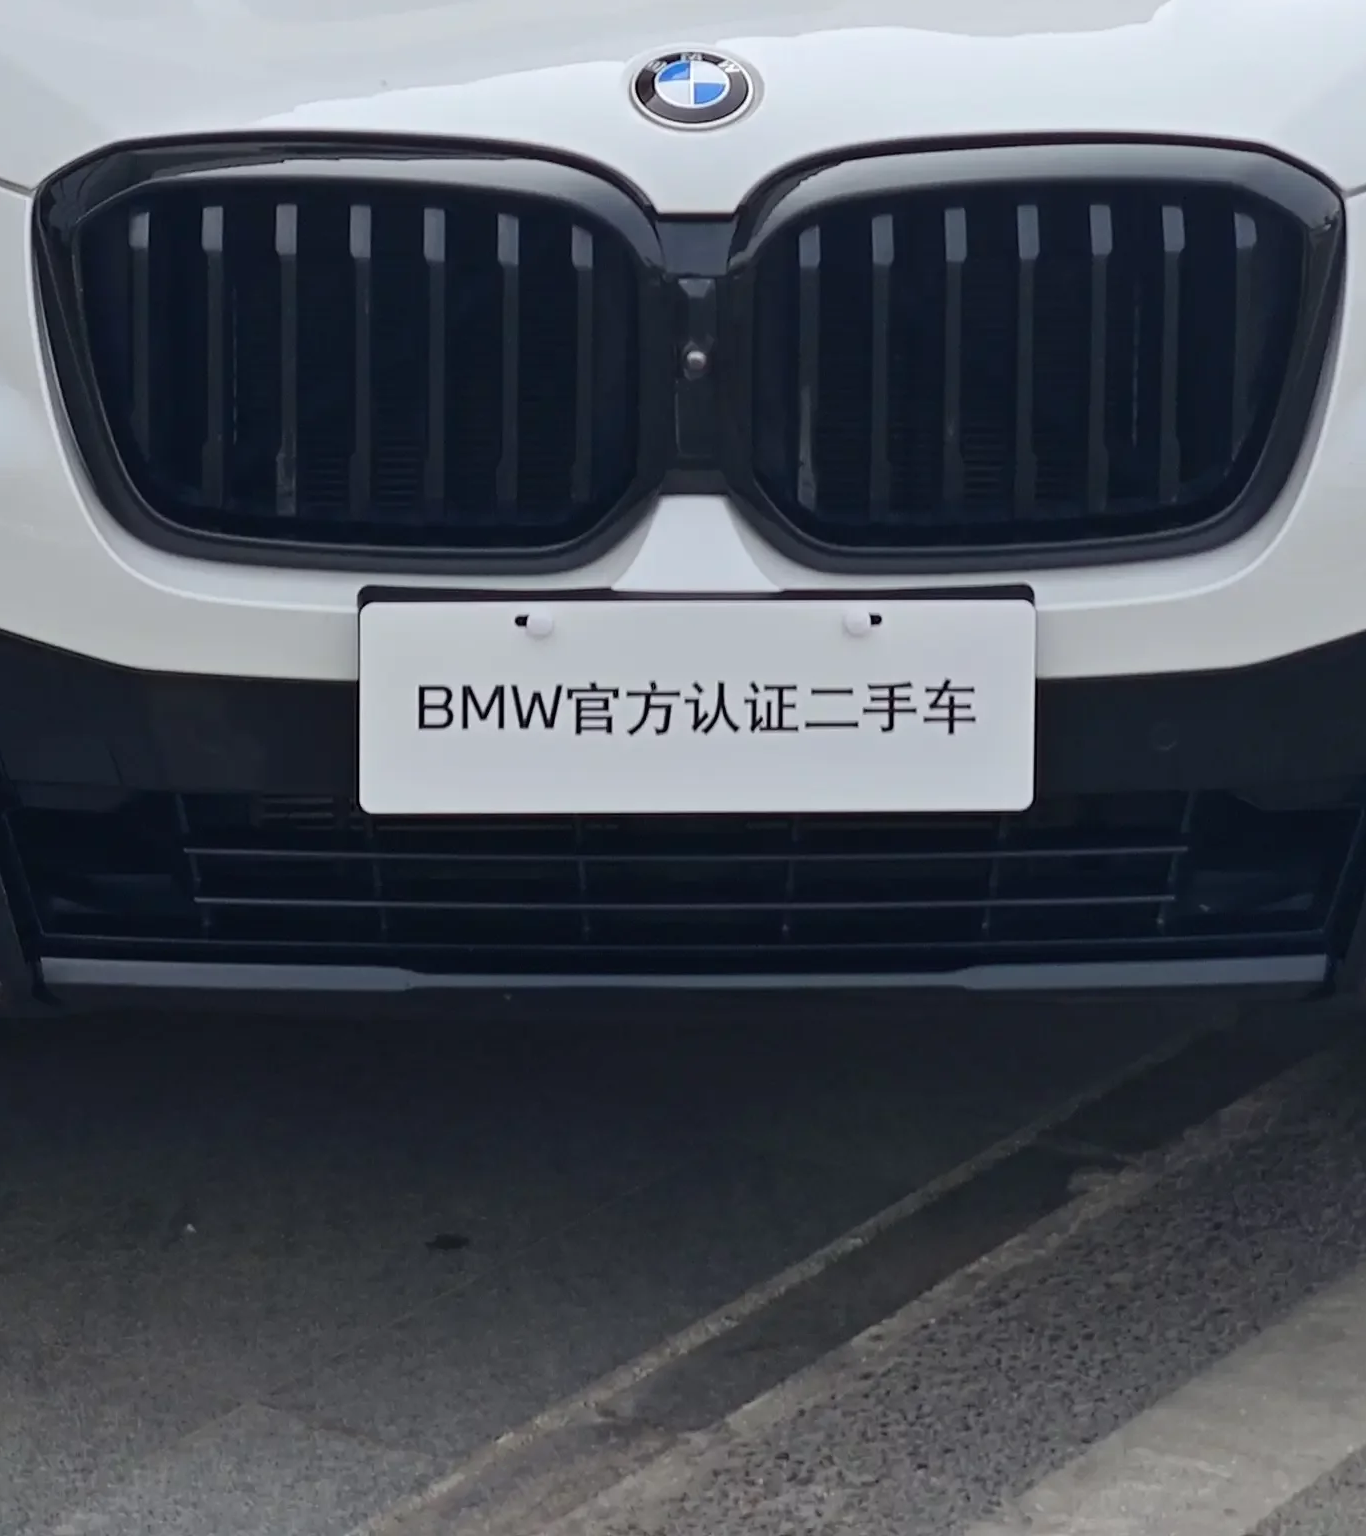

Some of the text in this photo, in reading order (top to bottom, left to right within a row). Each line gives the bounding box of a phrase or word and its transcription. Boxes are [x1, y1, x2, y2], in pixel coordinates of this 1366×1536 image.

[646, 52, 740, 73] BMW
[417, 679, 977, 735] BMW官方认证二手车
